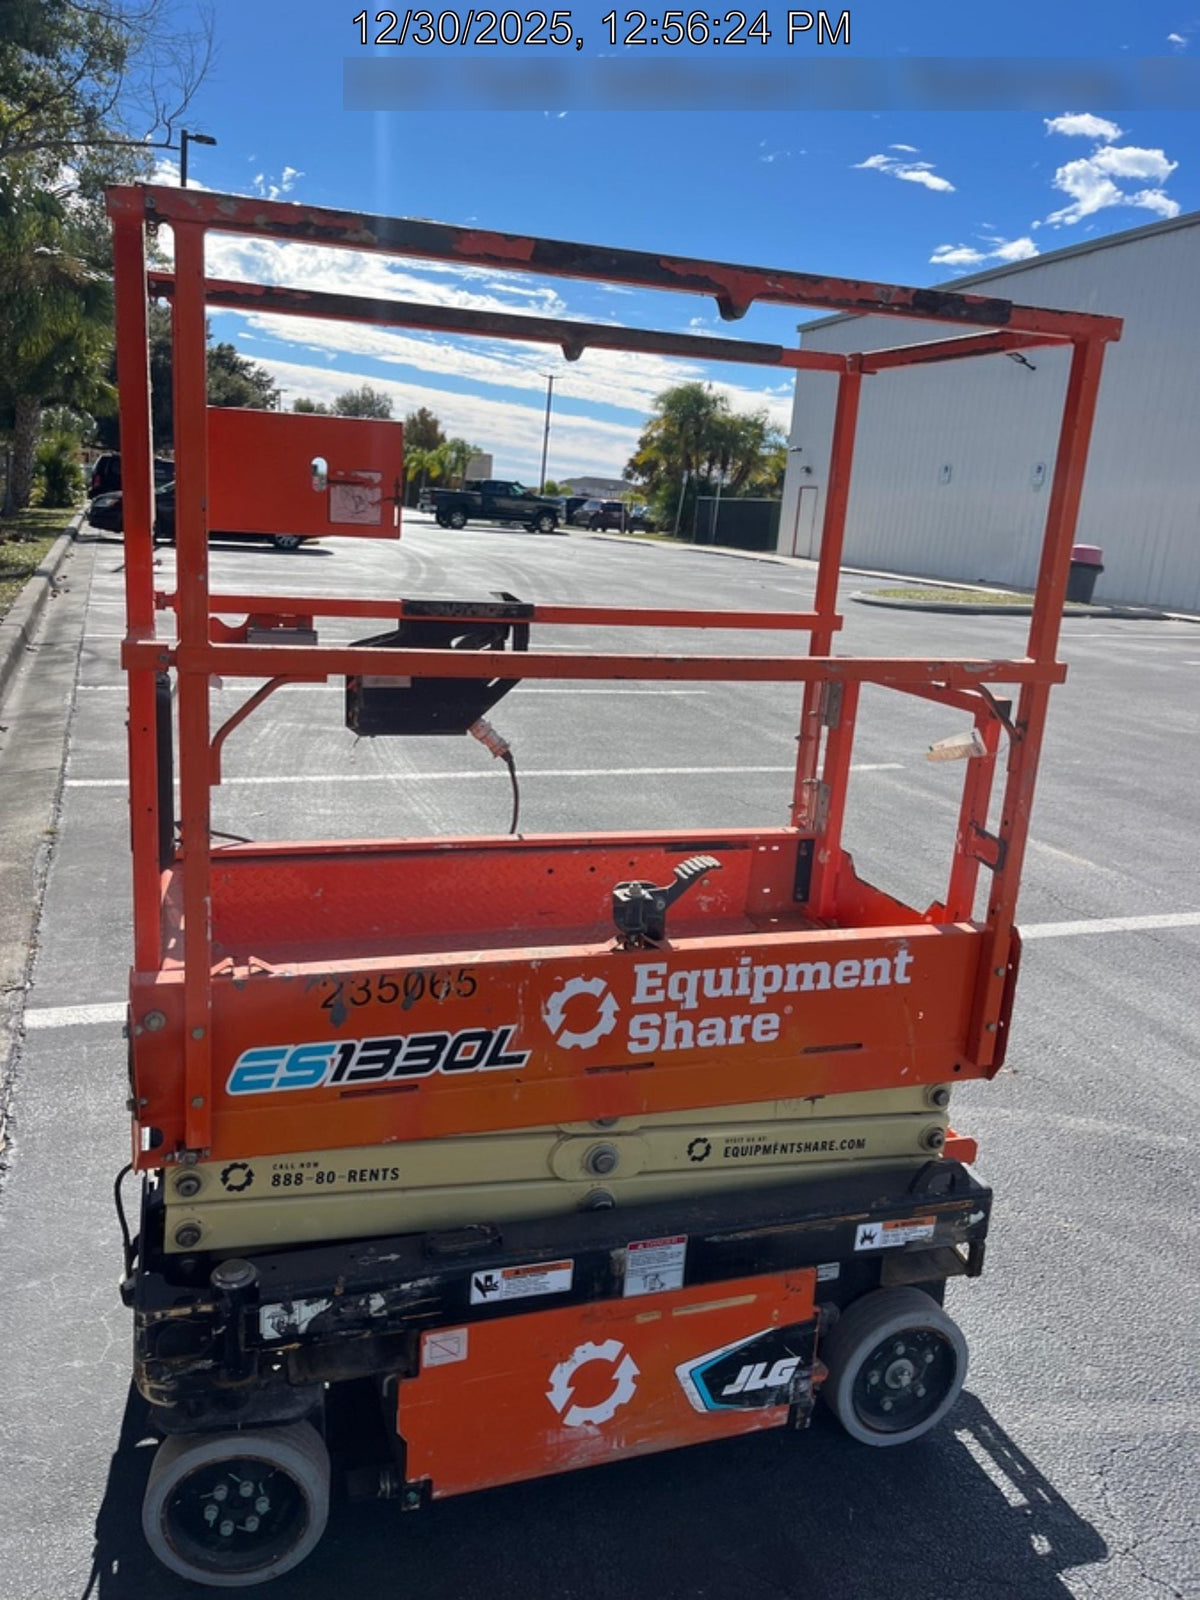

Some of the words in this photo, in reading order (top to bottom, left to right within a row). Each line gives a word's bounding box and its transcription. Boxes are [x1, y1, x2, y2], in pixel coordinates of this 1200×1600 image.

[320, 968, 478, 1009] 235065
[631, 949, 914, 1010] Equipment
[626, 1010, 781, 1055] Share
[225, 1023, 532, 1096] ES1330L
[272, 1163, 295, 1171] CALL
[299, 1161, 320, 1169] NOW
[723, 1138, 867, 1158] EQUIPMENTSHARE.COM
[271, 1167, 401, 1188] 888-80-RENTS
[721, 1356, 802, 1396] JLG
